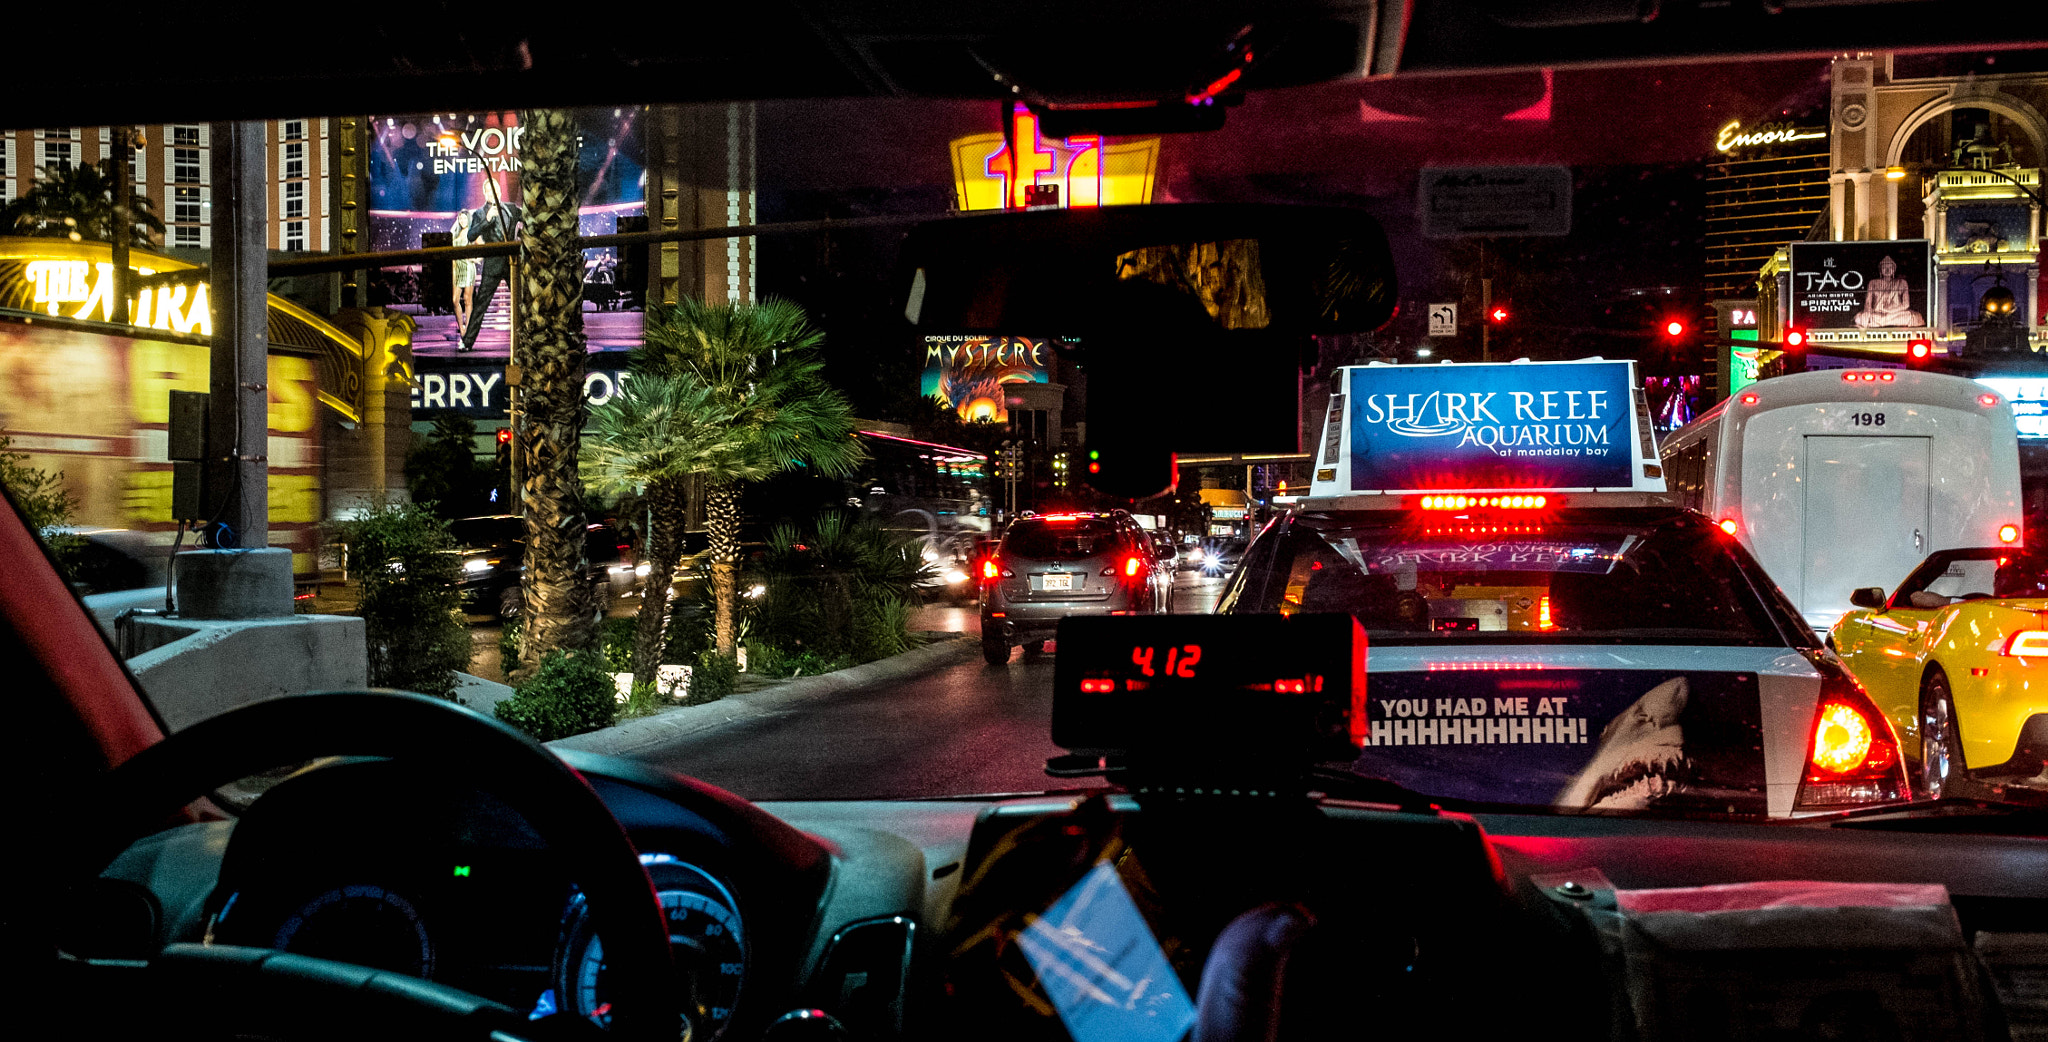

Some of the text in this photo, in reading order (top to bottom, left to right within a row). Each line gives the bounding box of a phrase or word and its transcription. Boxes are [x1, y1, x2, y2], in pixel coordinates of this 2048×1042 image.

[1716, 121, 1827, 151] Encore
[426, 141, 459, 157] THE
[433, 157, 523, 175] ENTERTAIN
[25, 260, 89, 304] THE
[1797, 270, 1863, 291] TAO
[1800, 299, 1860, 307] SPIRITUAL
[924, 335, 951, 343] CIRQUE
[1366, 390, 1608, 424] SHARK REEF
[1851, 412, 1886, 426] 198
[1456, 424, 1611, 455] AQUARIUM
[1499, 446, 1609, 458] at mandalay bay
[1380, 697, 1568, 717] YOU HAD ME AT
